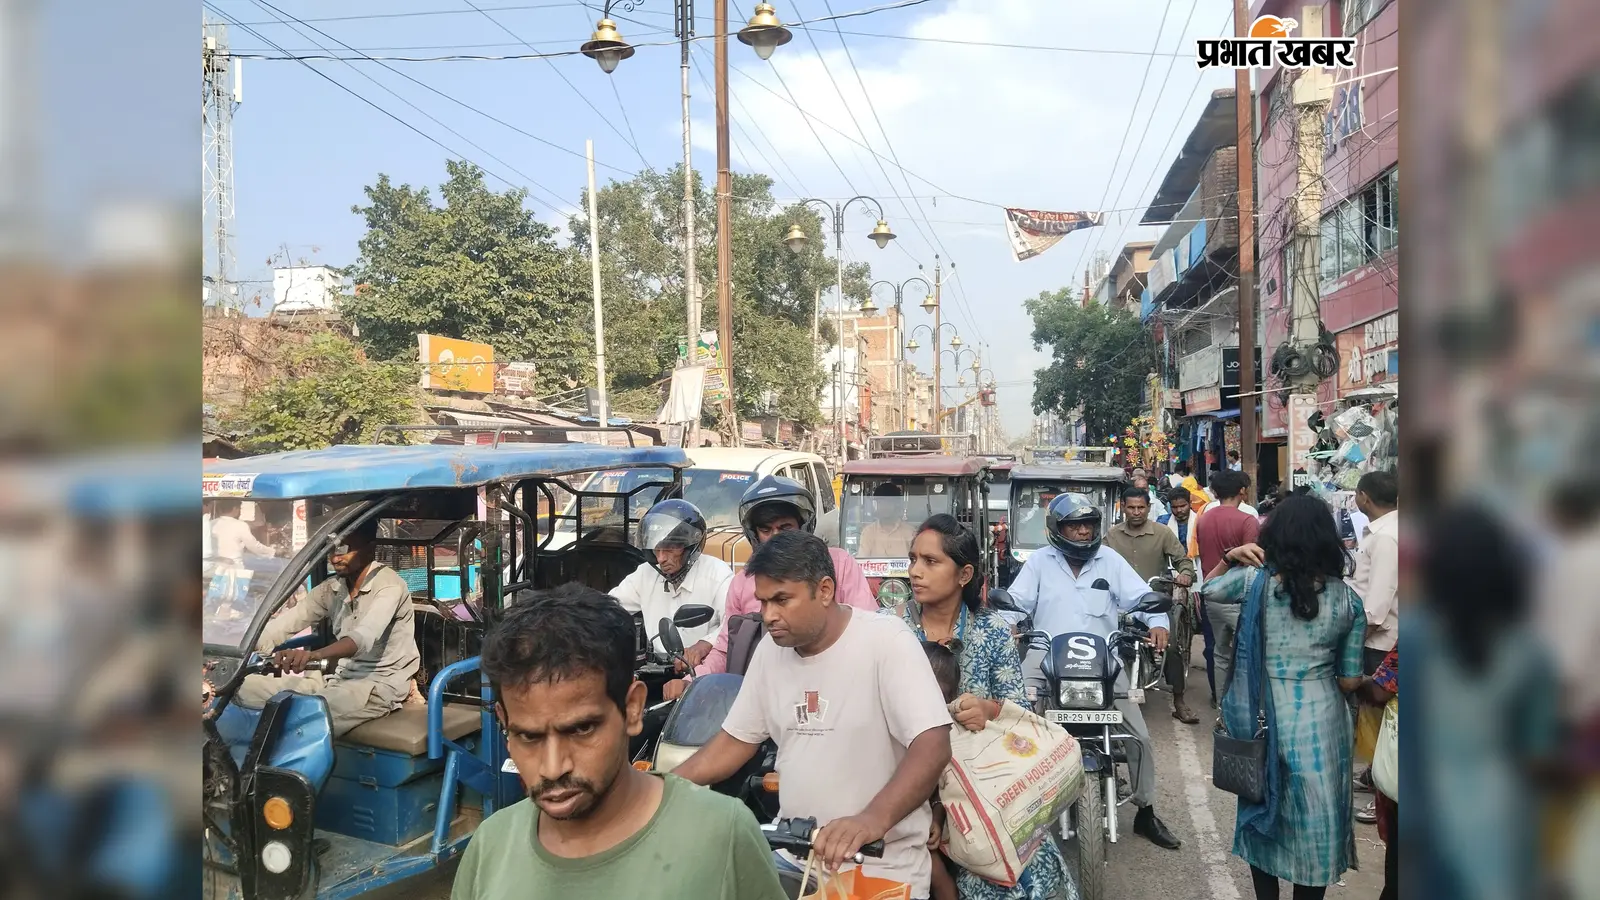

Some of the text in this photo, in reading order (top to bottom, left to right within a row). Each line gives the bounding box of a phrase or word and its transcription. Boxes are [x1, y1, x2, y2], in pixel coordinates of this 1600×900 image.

[1226, 361, 1261, 369] JOY
[722, 473, 750, 481] POLICE
[1067, 636, 1097, 660] S
[1057, 713, 1118, 722] BR-29 V 0766
[996, 780, 1028, 809] GREEN
[1025, 759, 1054, 785] HOUSE
